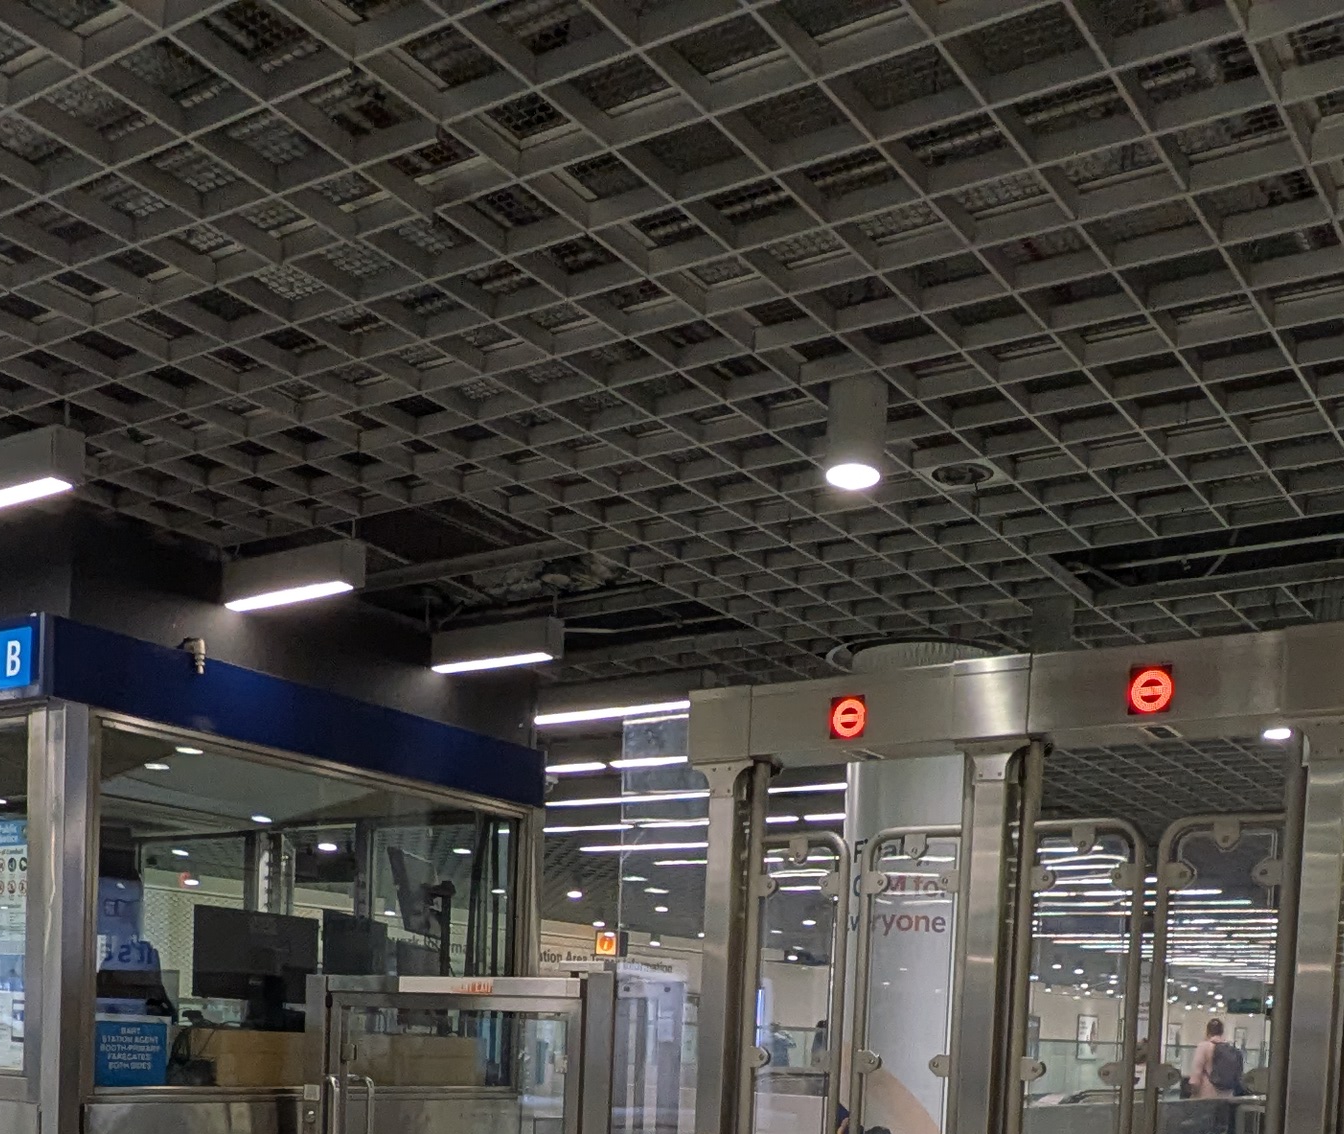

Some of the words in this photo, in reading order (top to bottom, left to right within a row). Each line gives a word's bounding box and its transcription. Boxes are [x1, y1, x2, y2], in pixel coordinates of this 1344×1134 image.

[6, 639, 21, 677] B
[101, 1035, 133, 1044] STATION
[134, 1035, 158, 1044] AGENT
